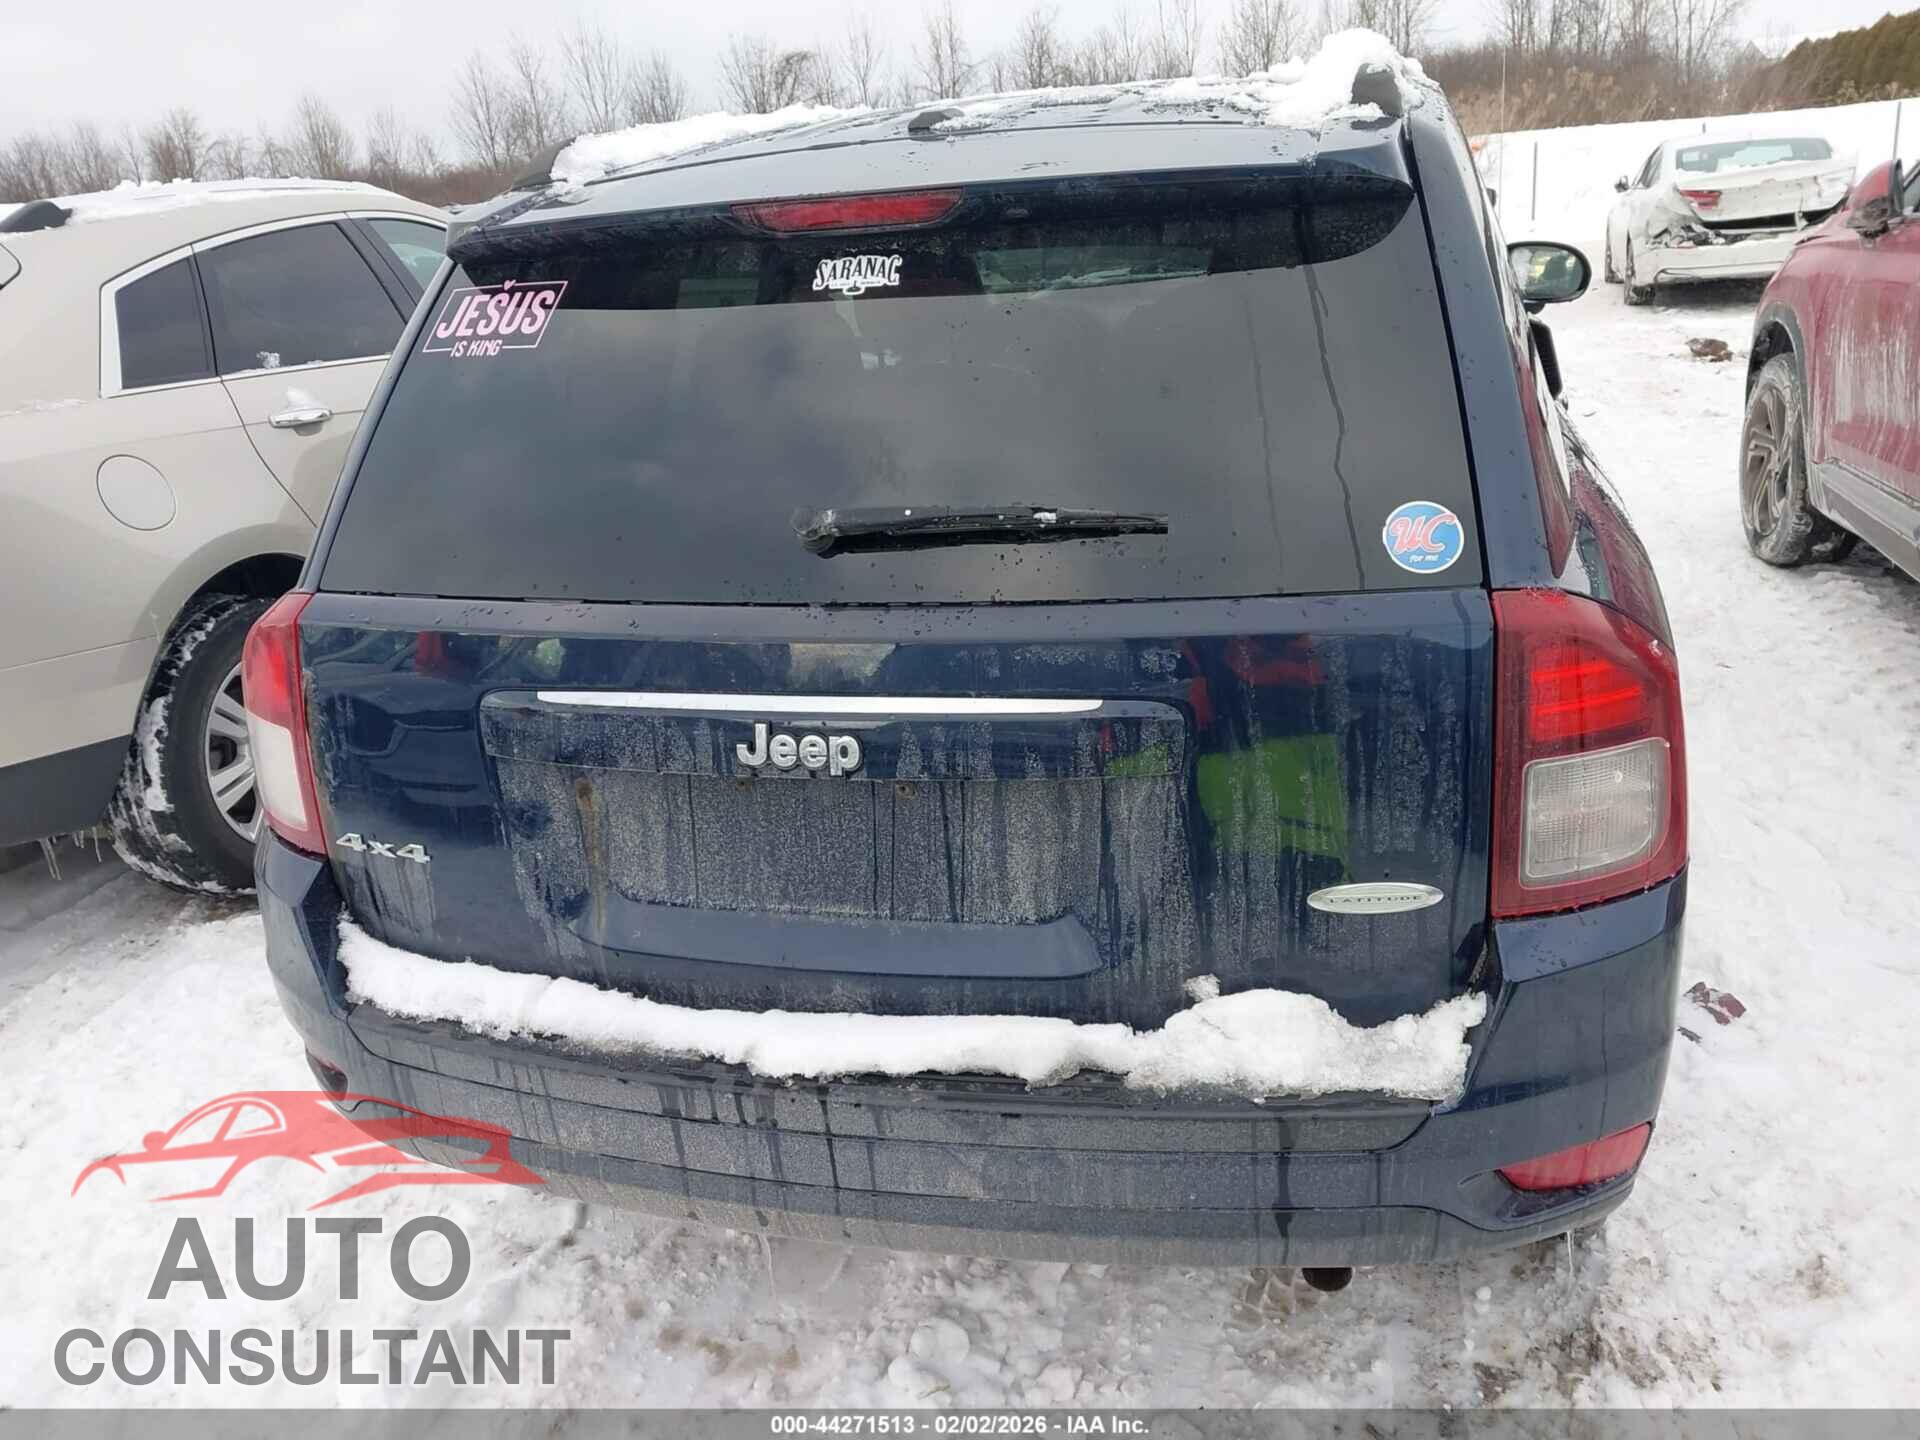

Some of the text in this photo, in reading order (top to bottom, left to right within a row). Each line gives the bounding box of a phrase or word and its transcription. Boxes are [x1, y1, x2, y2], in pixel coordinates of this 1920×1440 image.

[813, 254, 904, 290] SARANAC
[436, 290, 556, 339] JESUS
[450, 339, 503, 358] IS KING
[736, 722, 860, 777] Jeep
[336, 832, 432, 864] 4x4
[1329, 894, 1420, 905] LATITUDE
